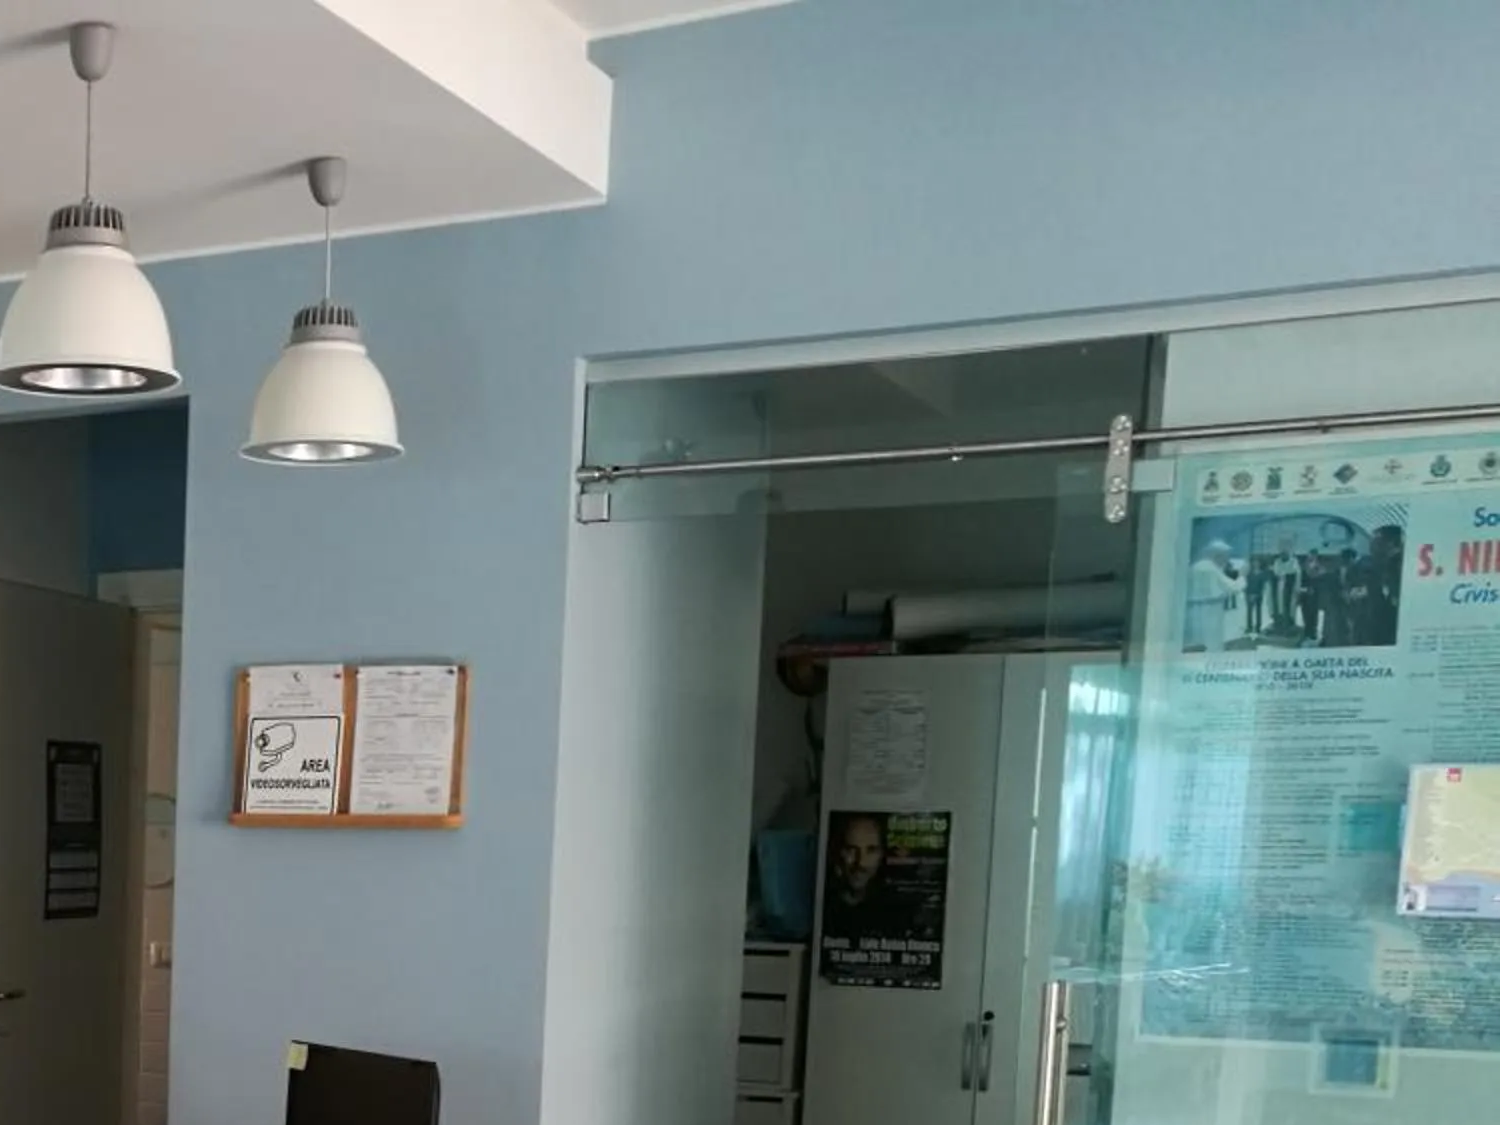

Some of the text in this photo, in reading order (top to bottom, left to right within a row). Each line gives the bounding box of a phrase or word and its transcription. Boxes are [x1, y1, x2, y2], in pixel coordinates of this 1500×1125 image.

[1418, 543, 1443, 577] S.
[1338, 667, 1394, 680] NASCITA
[299, 758, 331, 773] AREA
[250, 777, 331, 791] VIDEOSORVEGLIATA
